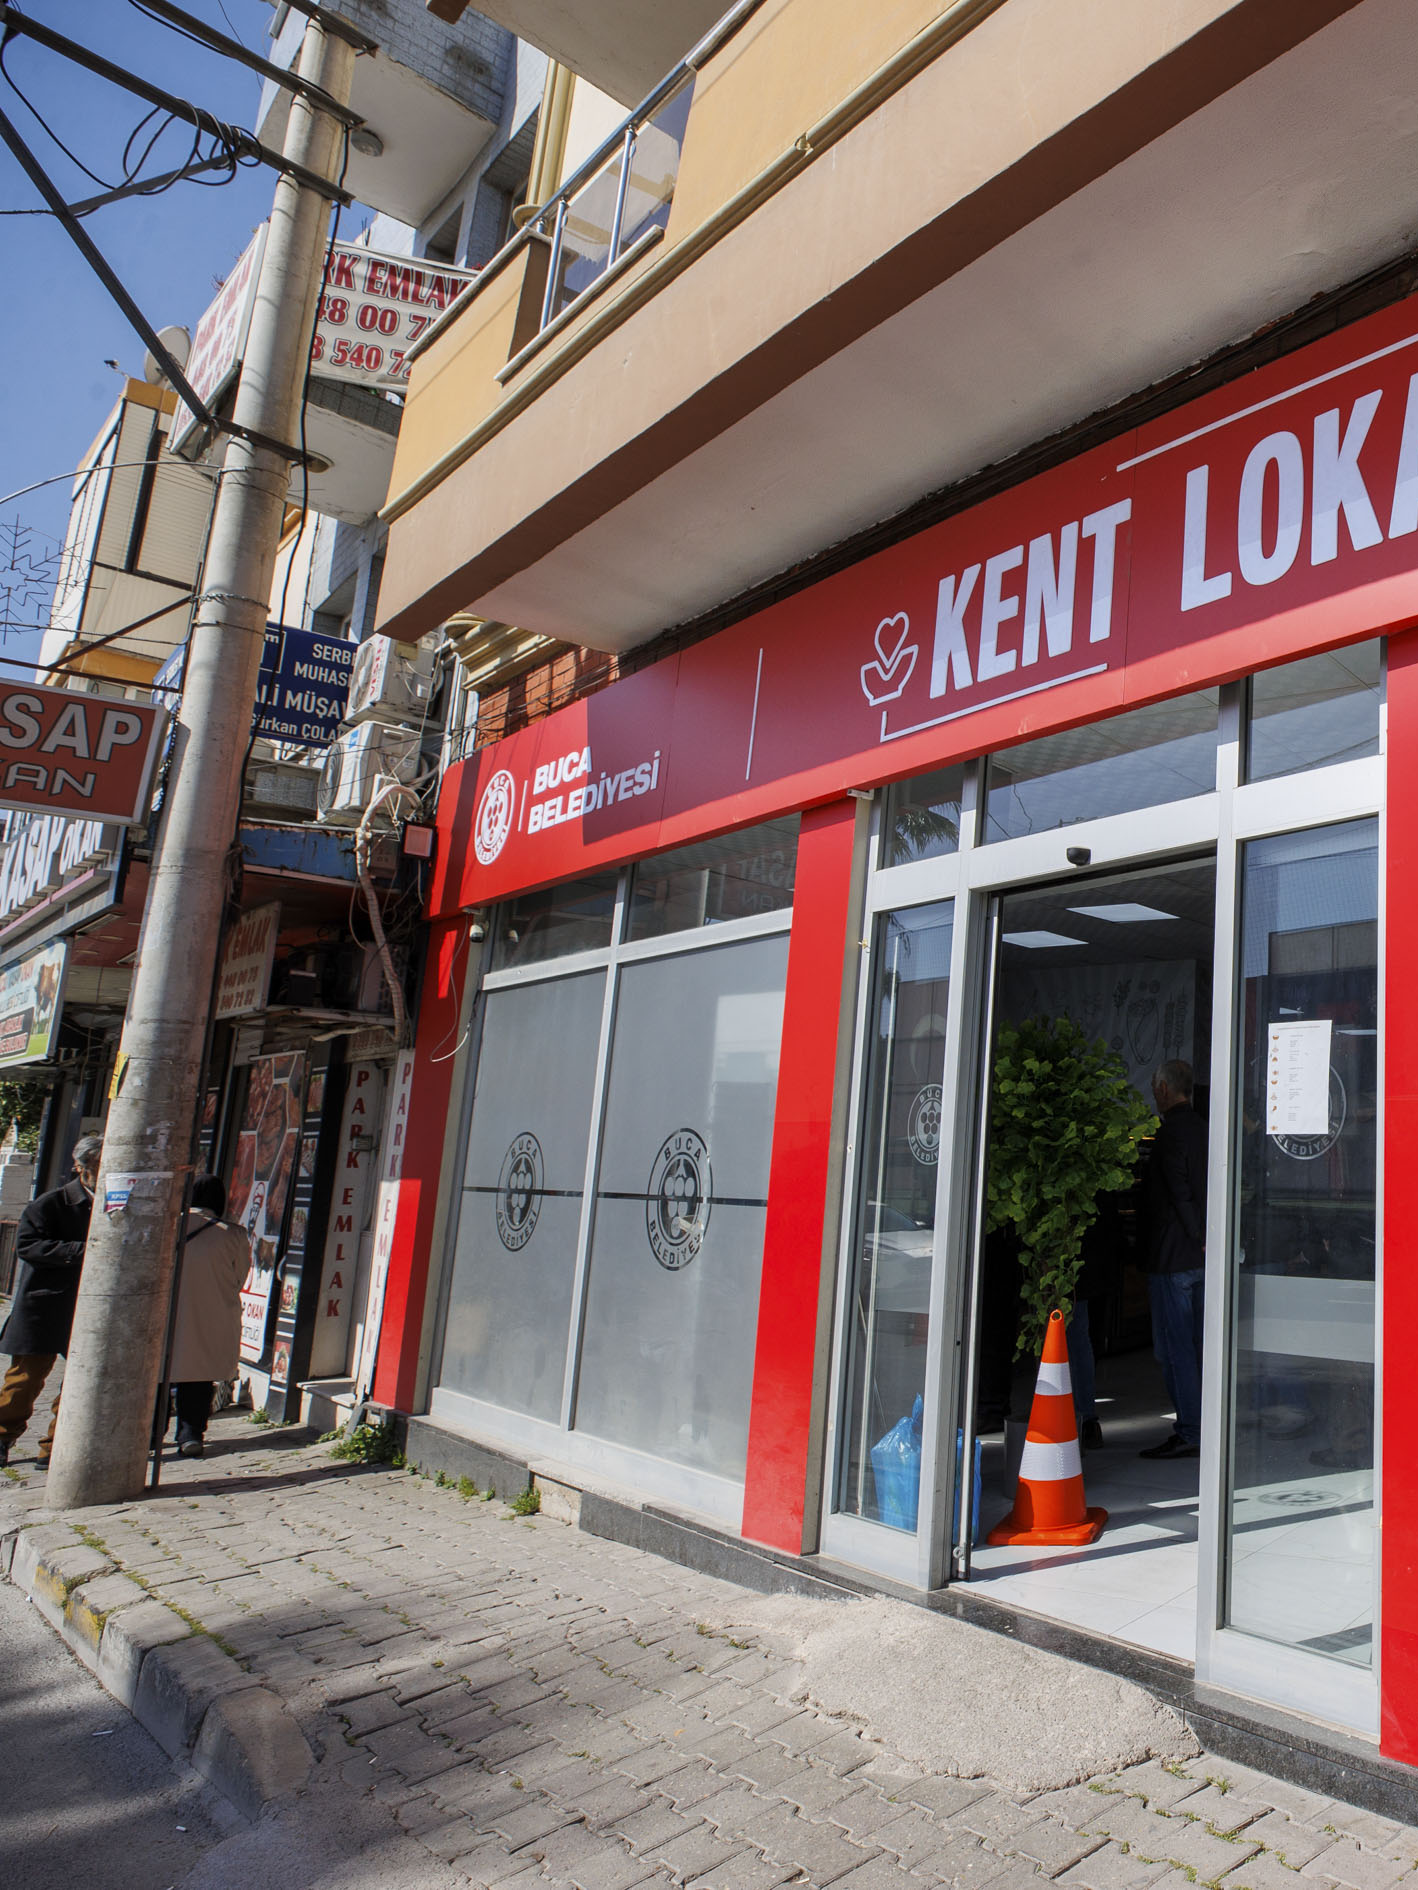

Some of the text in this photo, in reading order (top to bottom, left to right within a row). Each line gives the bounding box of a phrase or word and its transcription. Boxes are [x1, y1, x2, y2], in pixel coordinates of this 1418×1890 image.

[357, 303, 400, 336] 00
[407, 313, 438, 340] 7
[330, 338, 383, 372] 540
[387, 348, 412, 379] 7
[929, 498, 1132, 700] KENT
[0, 757, 98, 799] AN
[527, 749, 662, 835] BELEDİYESİ
[532, 745, 593, 796] BUCA
[388, 1062, 412, 1178] PARK
[511, 1139, 538, 1160] BUCA
[663, 1137, 702, 1162] BUCA
[326, 1187, 354, 1318] EMLAK
